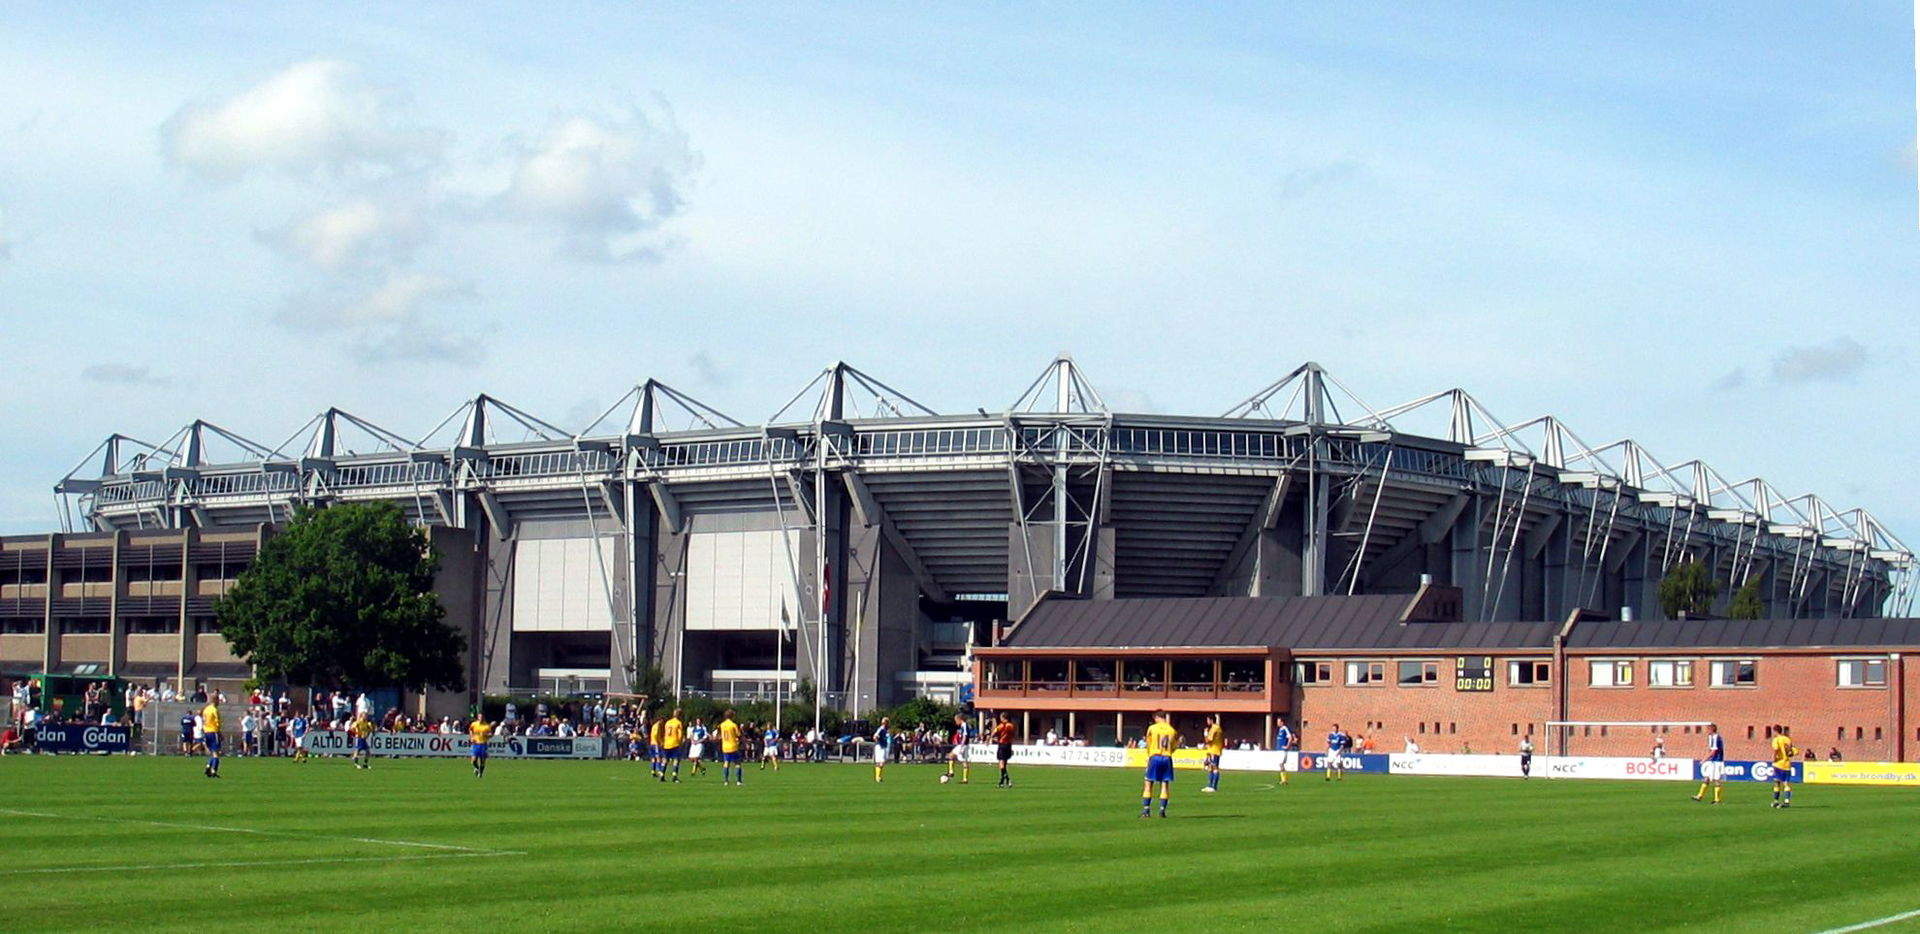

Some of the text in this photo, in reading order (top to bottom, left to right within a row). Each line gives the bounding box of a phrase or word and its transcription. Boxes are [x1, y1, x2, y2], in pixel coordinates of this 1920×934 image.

[1457, 656, 1492, 669] 0 0
[1457, 678, 1492, 690] 00:00
[82, 726, 127, 749] Codan
[311, 735, 343, 749] ALTID
[385, 737, 425, 750] BENZIN
[429, 737, 454, 752] OK
[536, 741, 598, 753] Danske Bank
[1552, 763, 1577, 773] NCC
[1626, 762, 1679, 775] BOSCH
